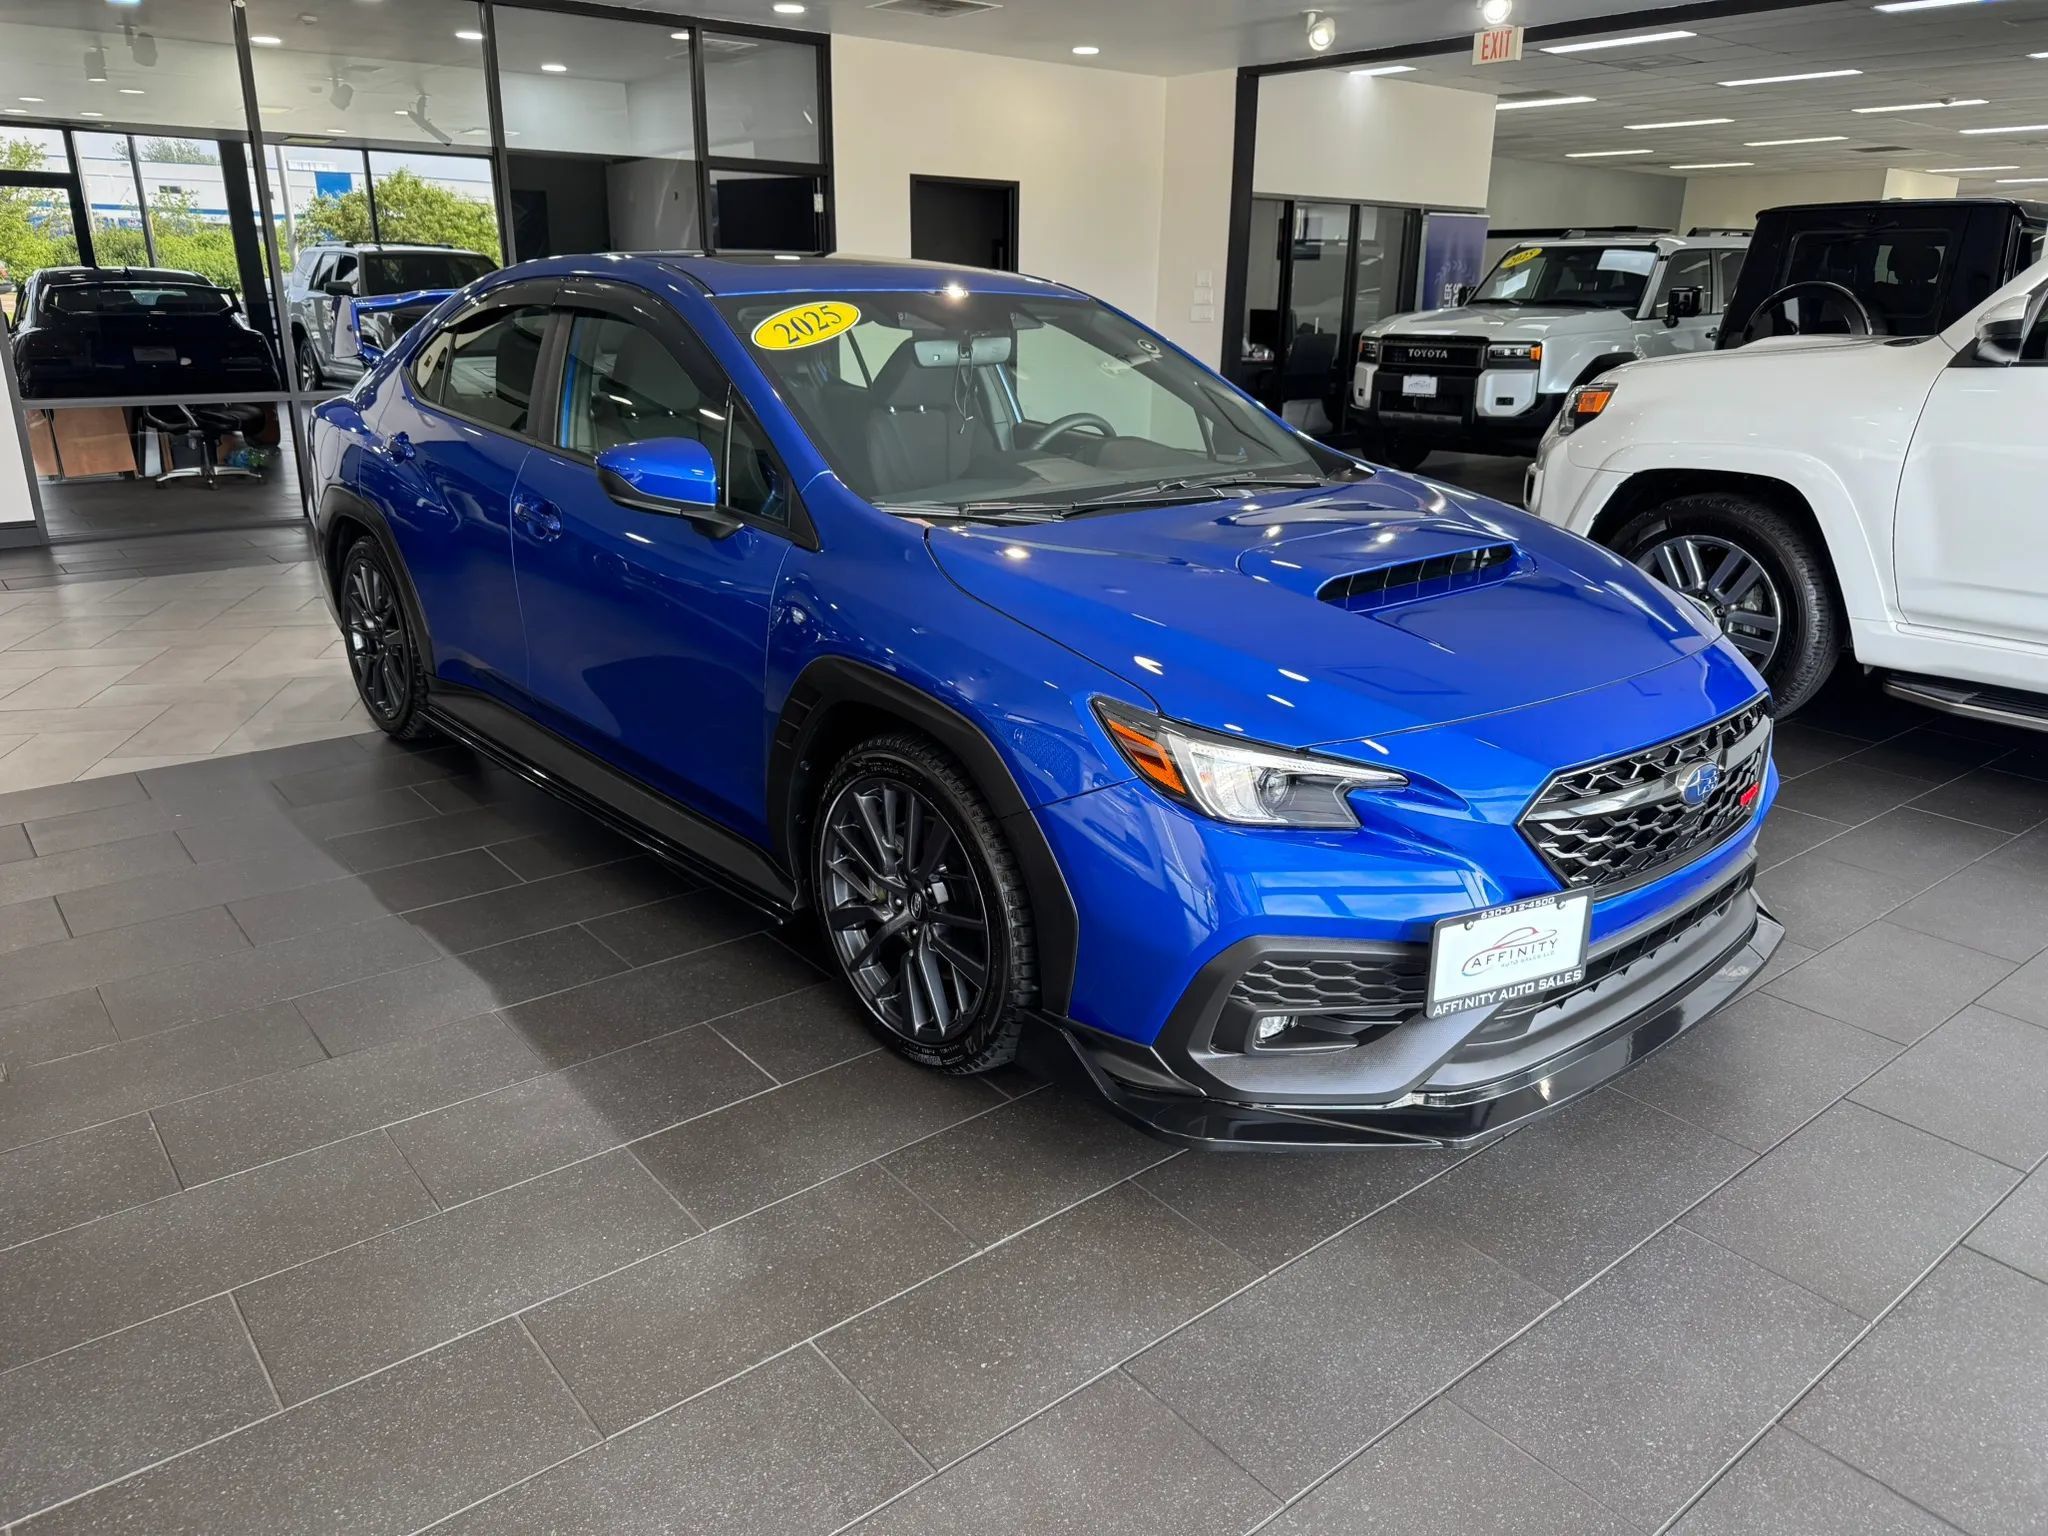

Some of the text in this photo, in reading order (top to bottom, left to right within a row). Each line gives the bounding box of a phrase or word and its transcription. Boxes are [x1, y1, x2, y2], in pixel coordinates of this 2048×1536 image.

[1481, 30, 1512, 60] EXIT
[773, 305, 842, 345] 2025
[1408, 348, 1448, 359] TOYOTA
[1480, 896, 1556, 920] 630-912-4500
[1471, 938, 1558, 969] AFFINITY
[1433, 969, 1582, 1017] AFFINITY AUTO SALES
